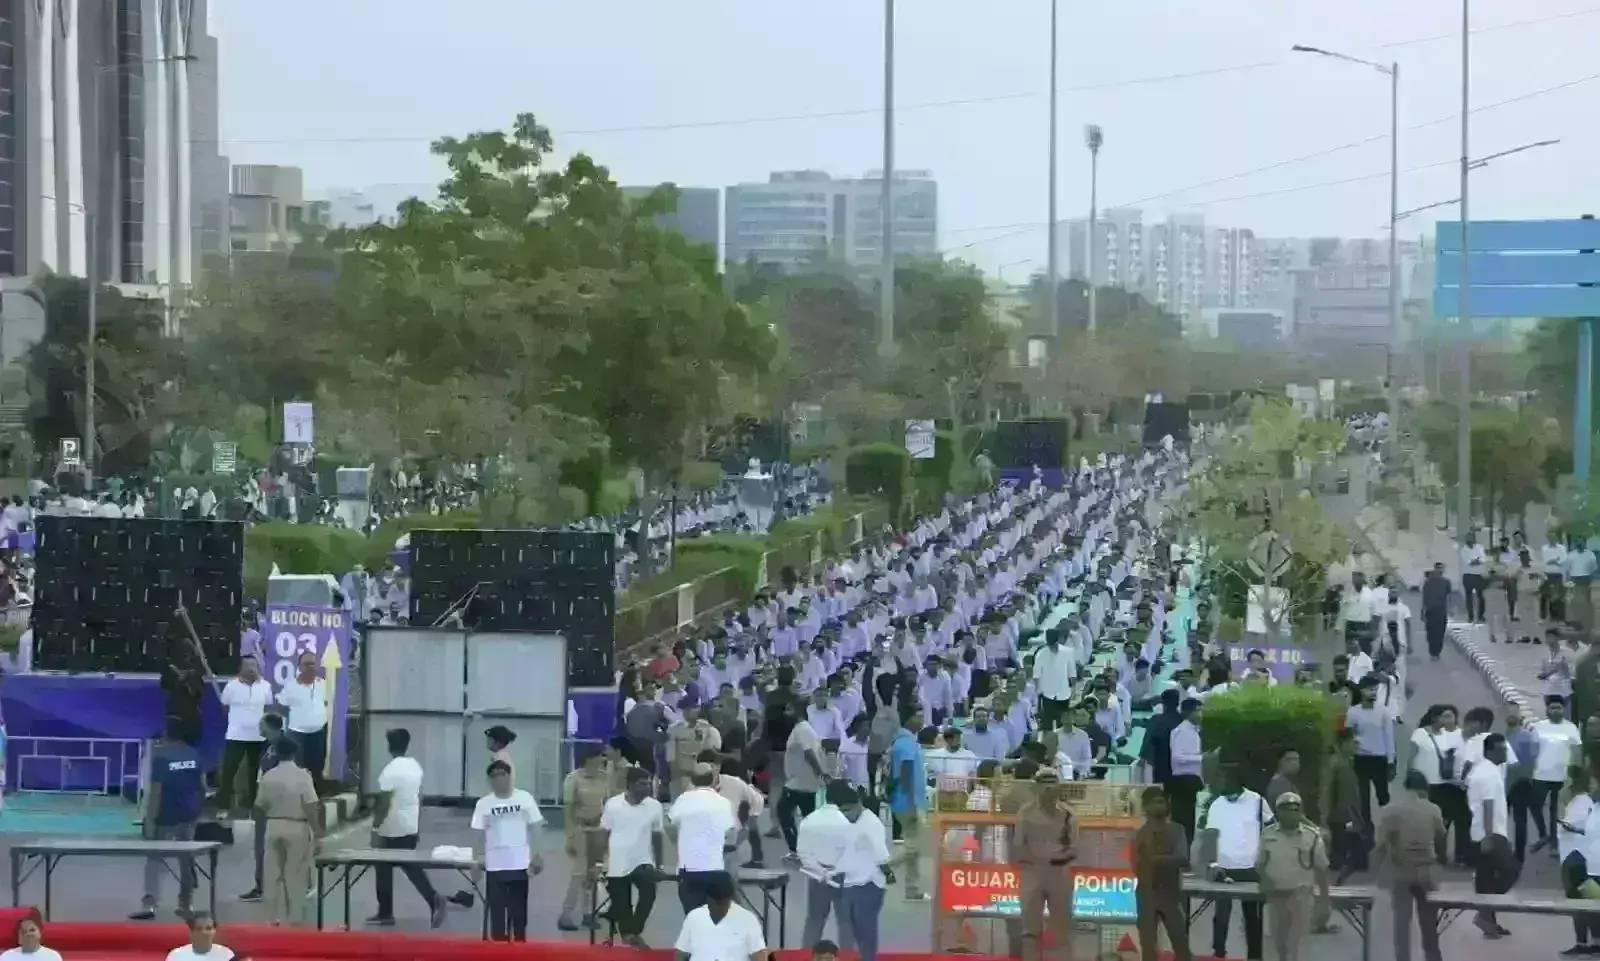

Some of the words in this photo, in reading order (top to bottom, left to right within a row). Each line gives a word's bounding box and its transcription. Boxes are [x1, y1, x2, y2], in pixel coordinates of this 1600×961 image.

[63, 440, 76, 456] P
[271, 610, 319, 627] BLOCK
[275, 631, 317, 658] 03
[168, 760, 196, 770] POLICE
[951, 869, 1019, 889] GUJAR
